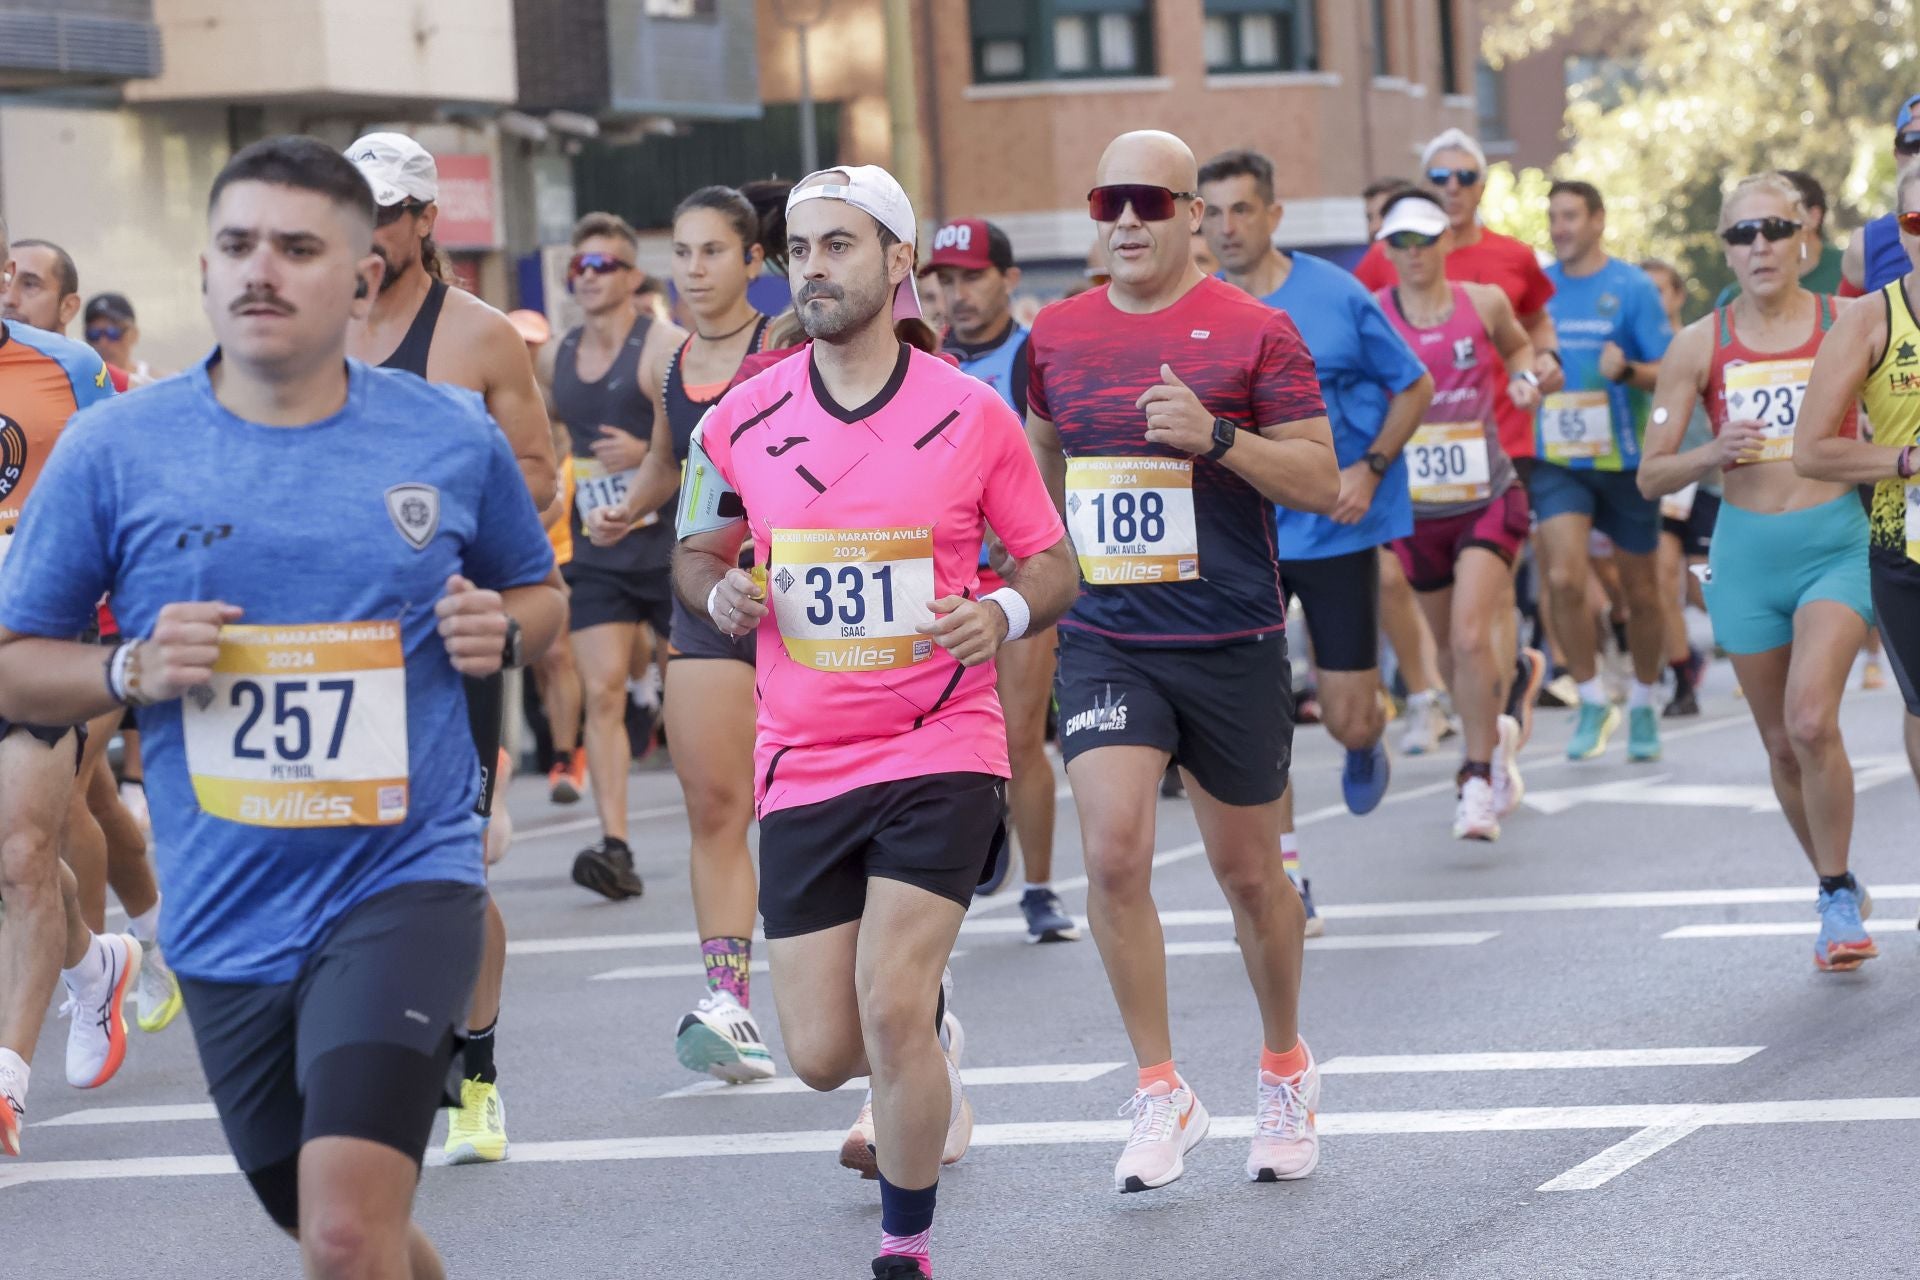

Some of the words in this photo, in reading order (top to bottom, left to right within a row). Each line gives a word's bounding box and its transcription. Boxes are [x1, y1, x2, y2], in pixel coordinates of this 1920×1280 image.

[1753, 386, 1807, 427] 23
[1558, 408, 1586, 440] 65
[1114, 460, 1158, 470] MARATÓN
[1159, 461, 1190, 472] AVILÉS
[1416, 445, 1466, 477] 330
[1109, 474, 1137, 485] 2024
[585, 475, 626, 509] 315
[1091, 491, 1165, 543] 188
[804, 532, 835, 543] MEDIA
[838, 529, 890, 541] MARATÓN
[892, 527, 928, 540] AVILÉS
[833, 546, 866, 558] 2024
[1105, 545, 1120, 555] JUKI
[1122, 544, 1147, 554] AVILÉS
[1092, 561, 1163, 580] avilés
[805, 565, 894, 625] 331
[841, 626, 866, 638] ISAAC
[267, 651, 316, 668] 2024
[815, 645, 896, 667] avilés
[230, 680, 355, 761] 257
[238, 789, 354, 821] avilés
